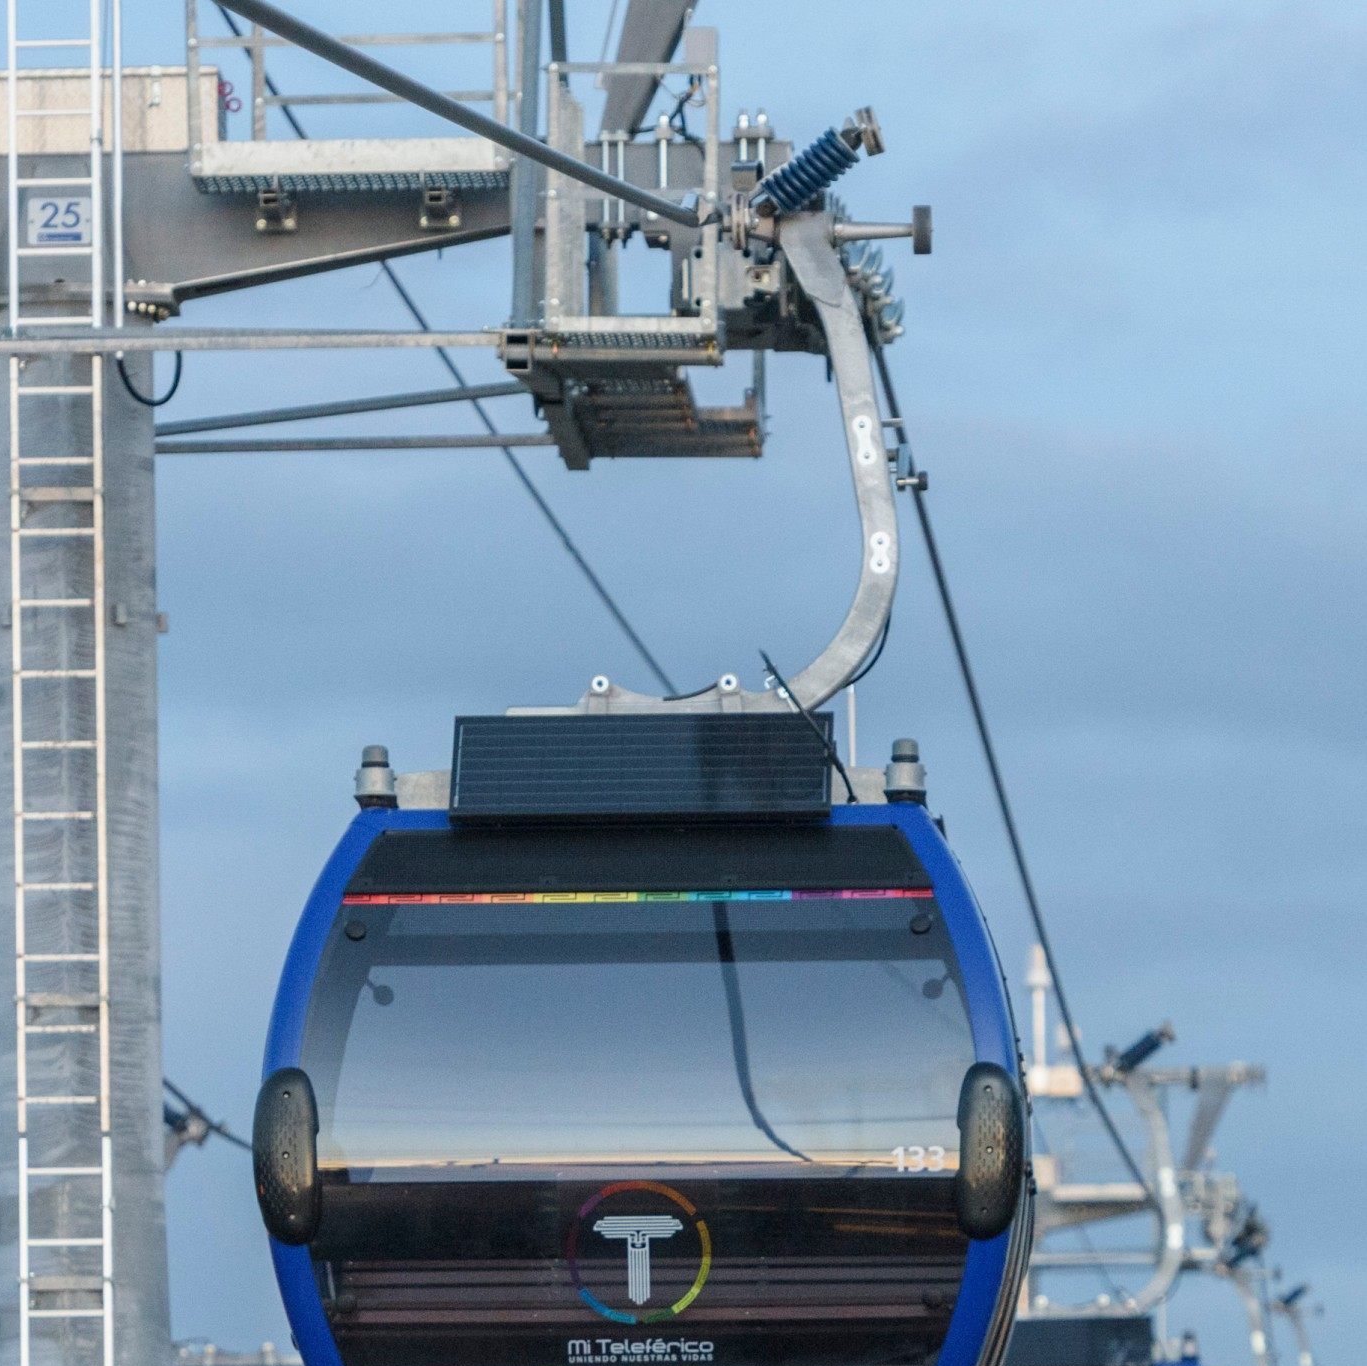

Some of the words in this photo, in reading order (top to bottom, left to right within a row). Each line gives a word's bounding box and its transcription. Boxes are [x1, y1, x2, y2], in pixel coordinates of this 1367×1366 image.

[40, 201, 82, 229] 25
[891, 1145, 945, 1172] 133
[595, 1338, 714, 1354] Teleférico
[568, 1355, 617, 1363] UNIENDO
[621, 1354, 677, 1362] NUESTRAS
[681, 1353, 714, 1361] VIDAS
